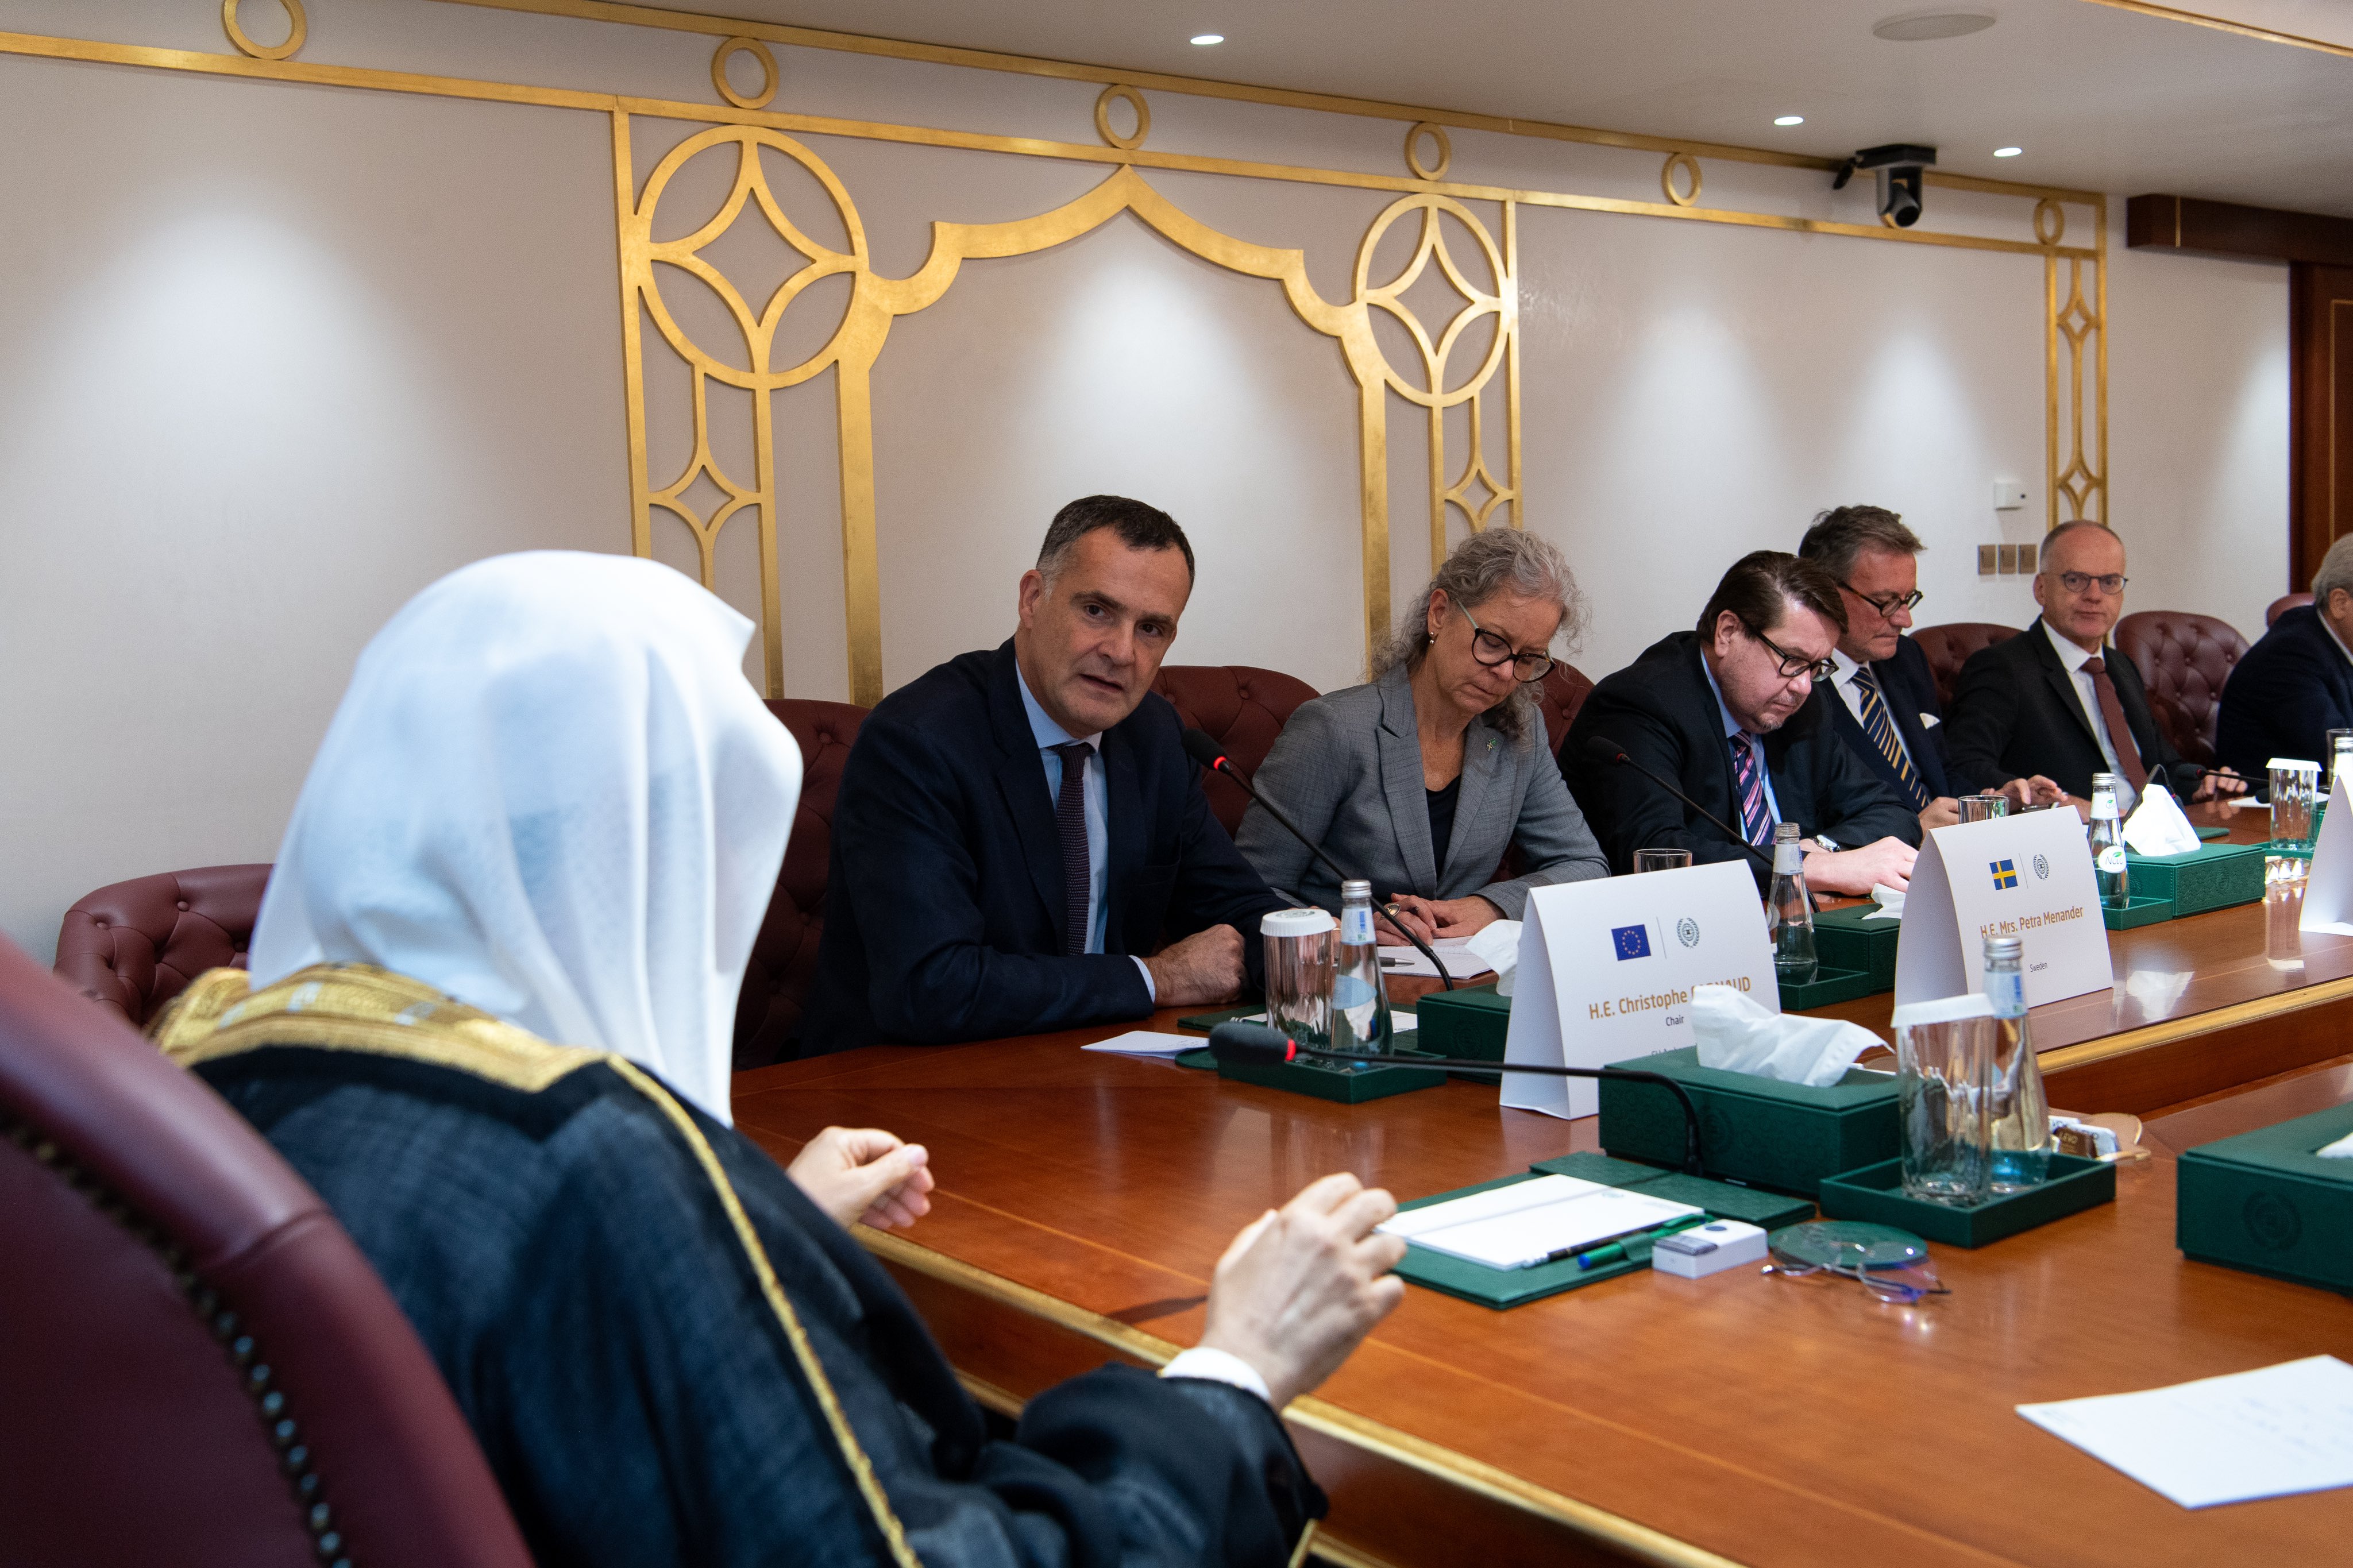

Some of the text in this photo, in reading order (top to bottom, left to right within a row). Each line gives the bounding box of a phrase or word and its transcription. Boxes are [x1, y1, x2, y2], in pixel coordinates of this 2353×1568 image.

[1980, 906, 2084, 939] H.E. Mrs. Petra Menander
[2030, 961, 2048, 972] Sweden
[1589, 989, 1688, 1019] H.E. Christophe
[1665, 1014, 1684, 1026] Chair
